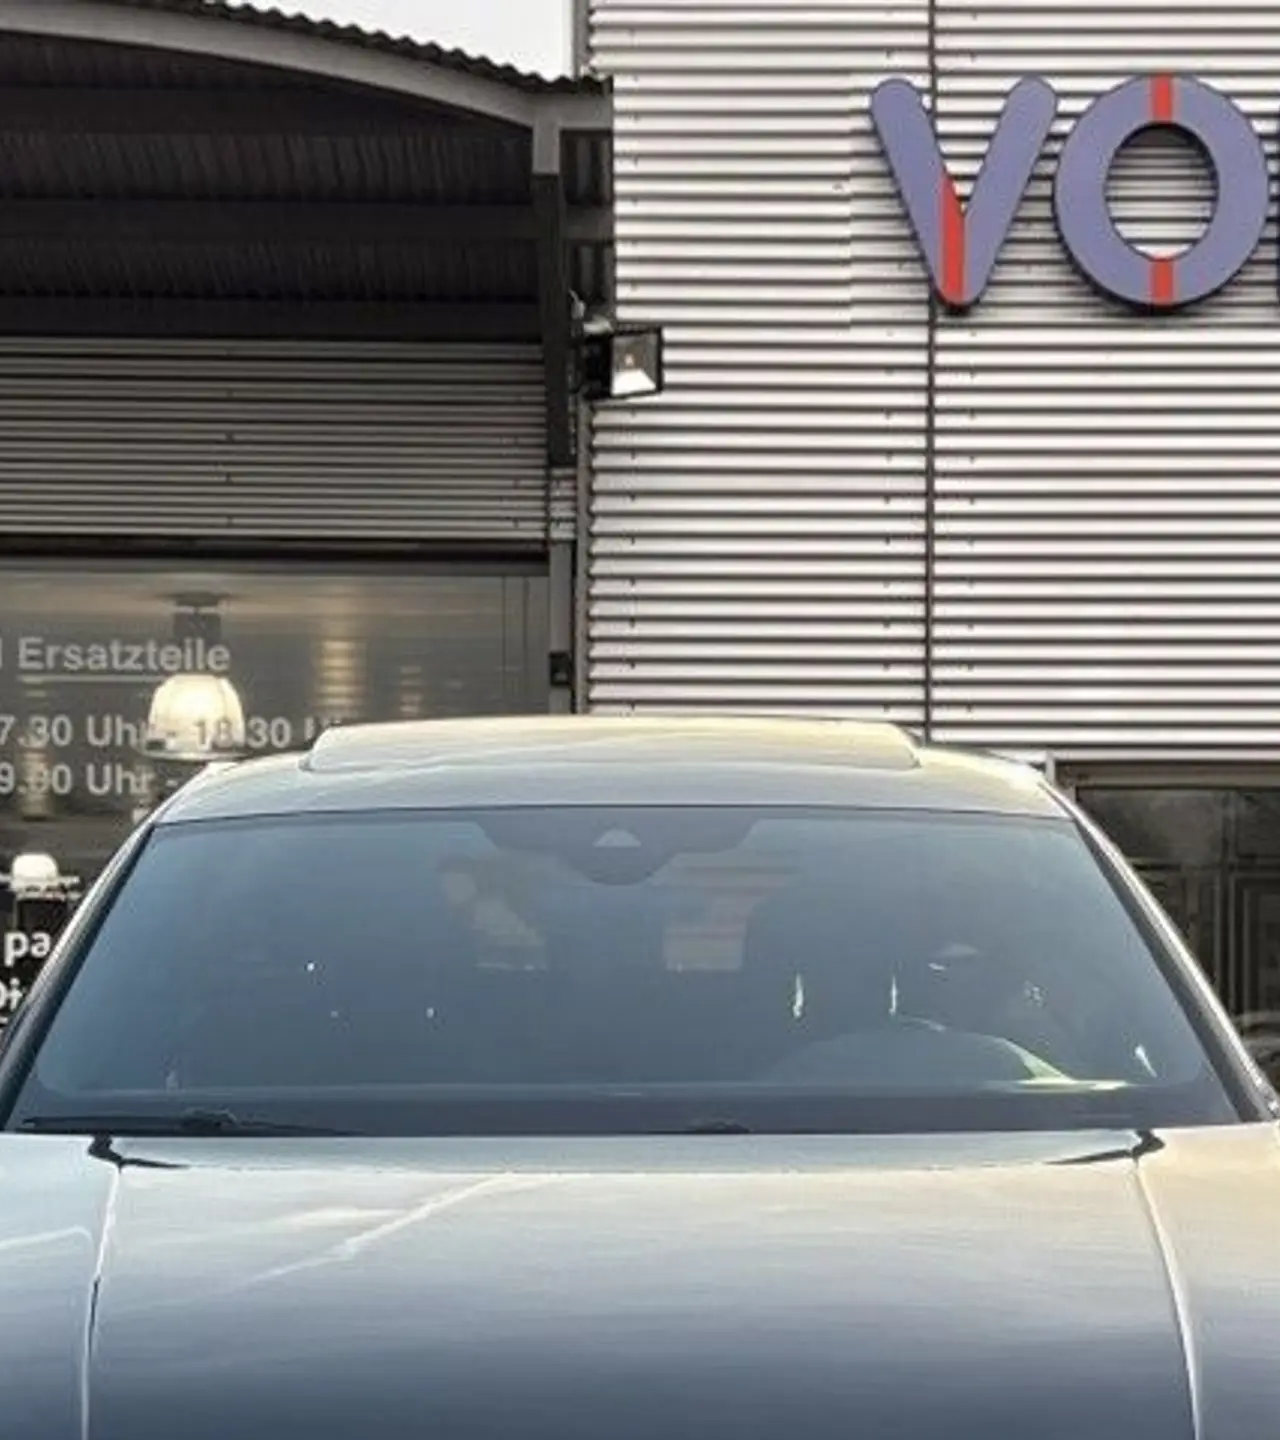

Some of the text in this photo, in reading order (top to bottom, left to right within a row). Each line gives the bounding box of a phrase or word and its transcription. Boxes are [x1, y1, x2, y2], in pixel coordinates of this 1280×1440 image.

[19, 636, 230, 671] Ersatzteile
[194, 715, 292, 749] 1830
[86, 763, 154, 795] Uhr
[3, 932, 52, 966] pa
